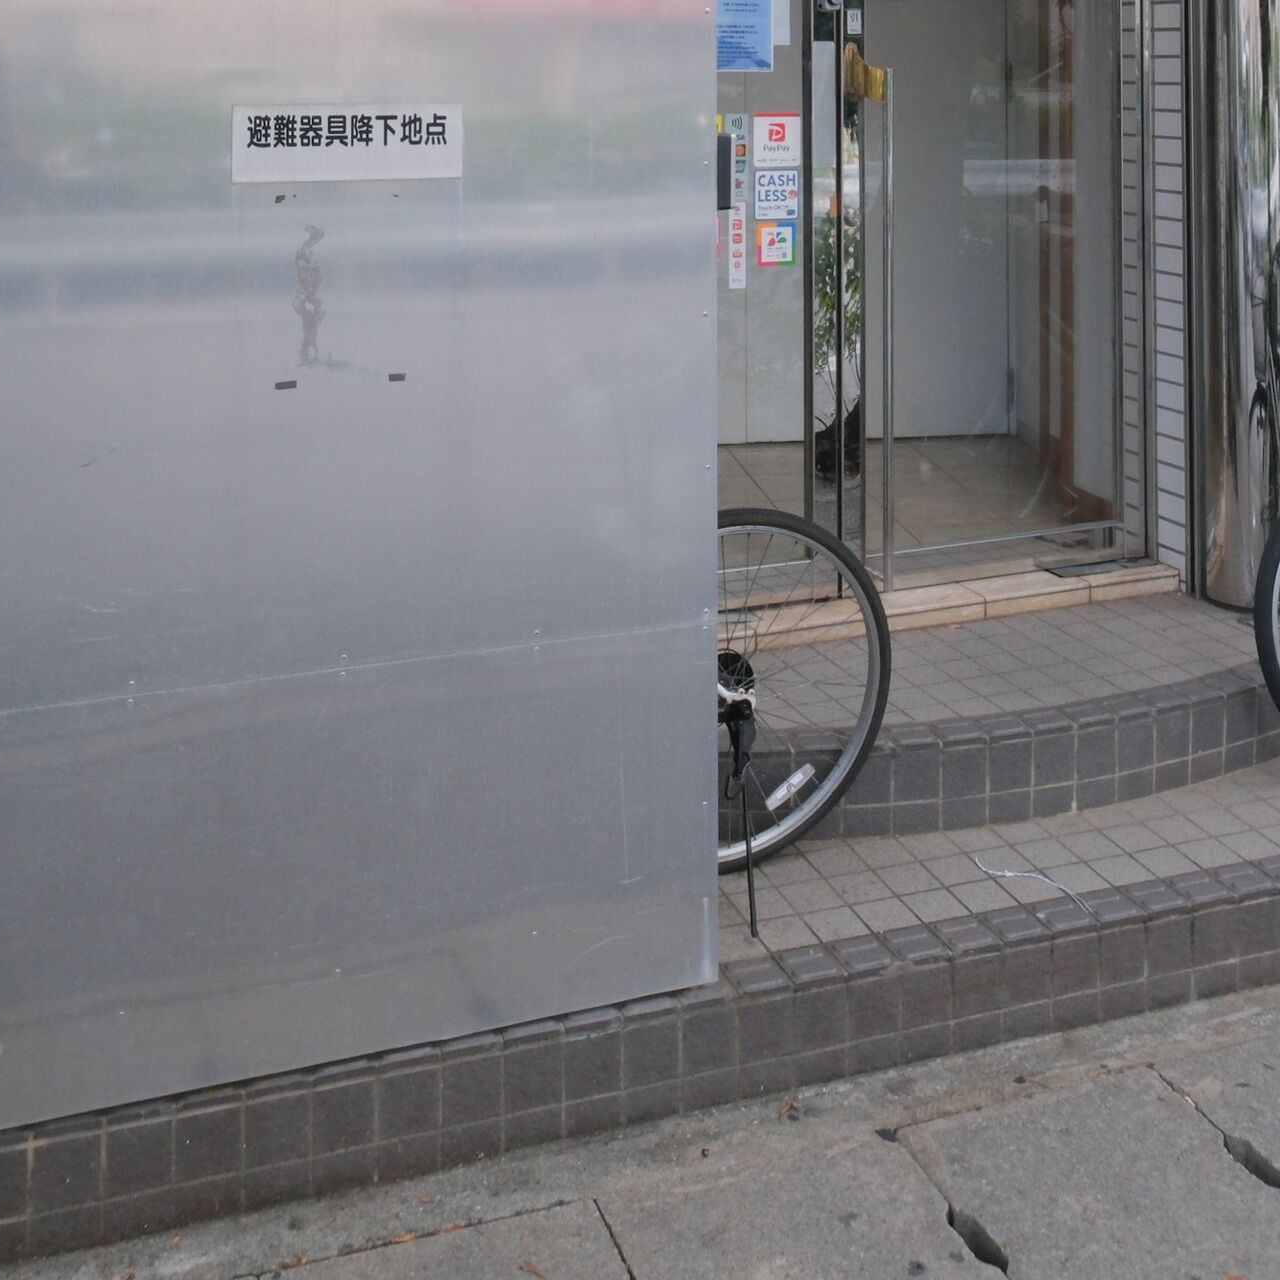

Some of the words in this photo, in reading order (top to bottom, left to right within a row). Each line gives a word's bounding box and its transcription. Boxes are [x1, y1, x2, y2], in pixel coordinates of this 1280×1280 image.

[246, 113, 448, 150] 避難器具降下地点
[763, 144, 791, 153] PayPay
[758, 174, 797, 187] CASH
[757, 189, 788, 202] LESS
